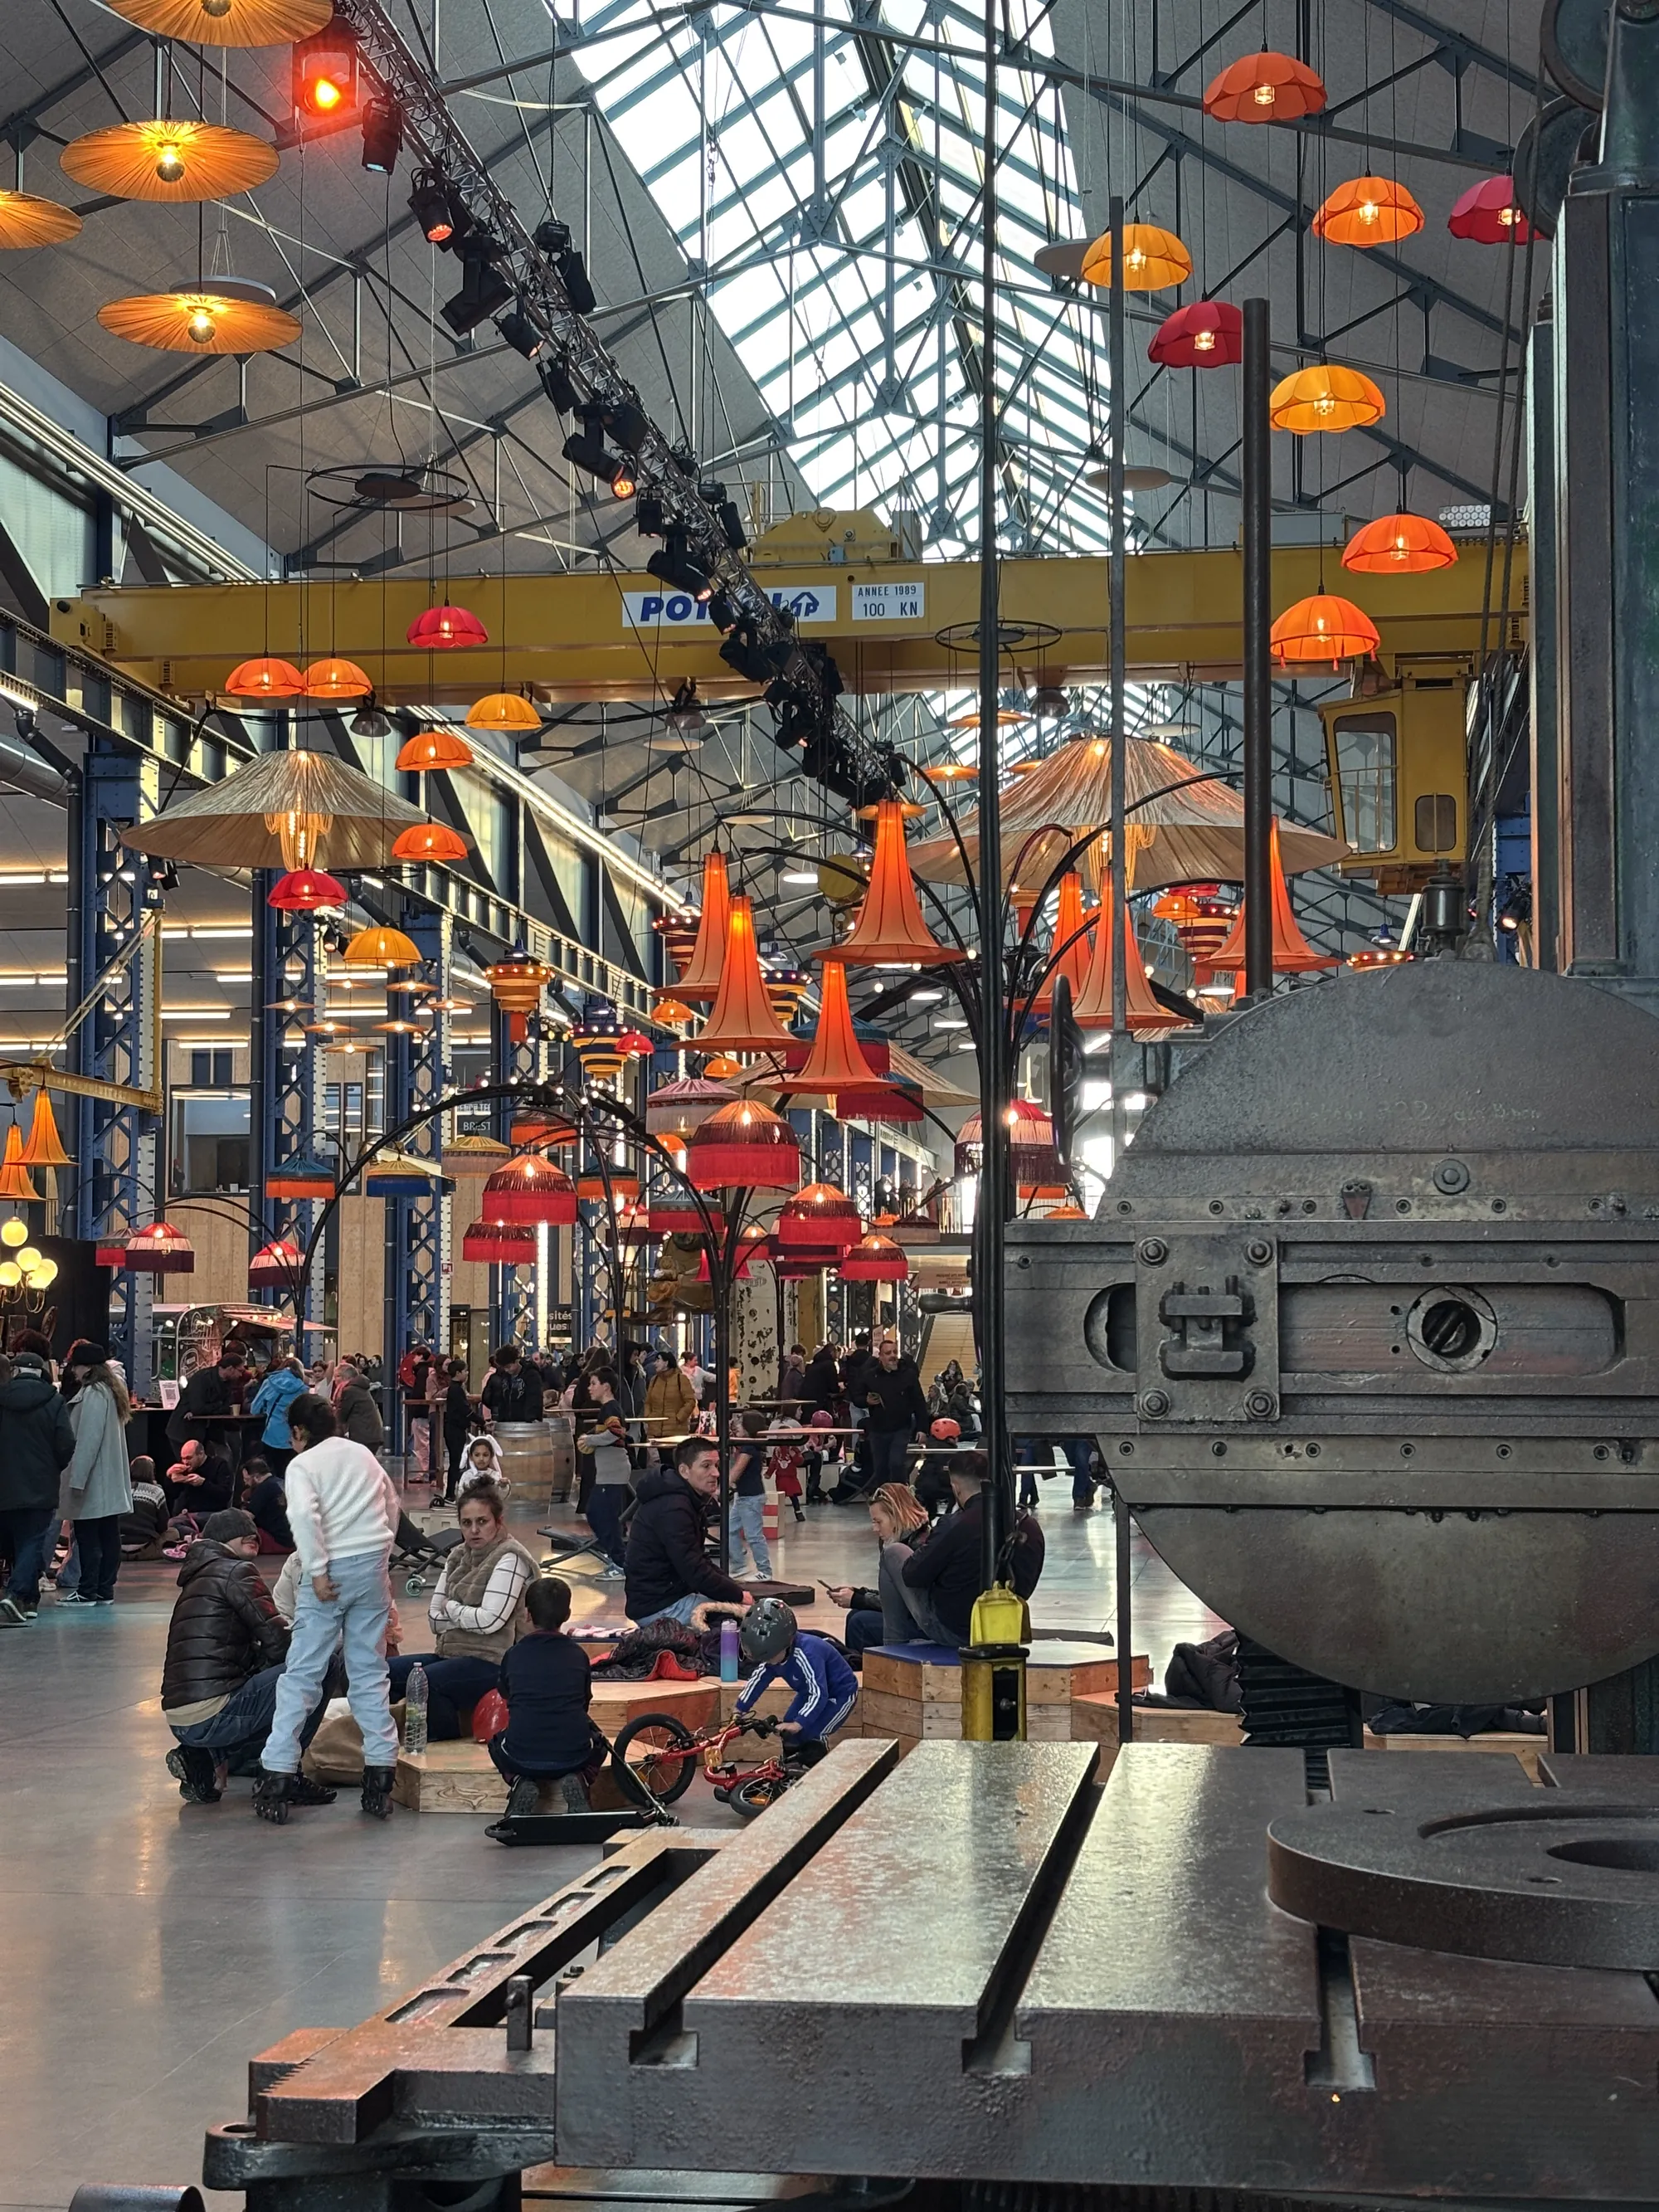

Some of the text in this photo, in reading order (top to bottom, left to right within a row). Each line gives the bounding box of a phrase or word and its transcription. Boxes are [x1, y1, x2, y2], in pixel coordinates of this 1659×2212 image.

[858, 585, 917, 597] ANNEE 1989
[863, 602, 917, 617] 100 KN
[548, 1310, 572, 1320] sités
